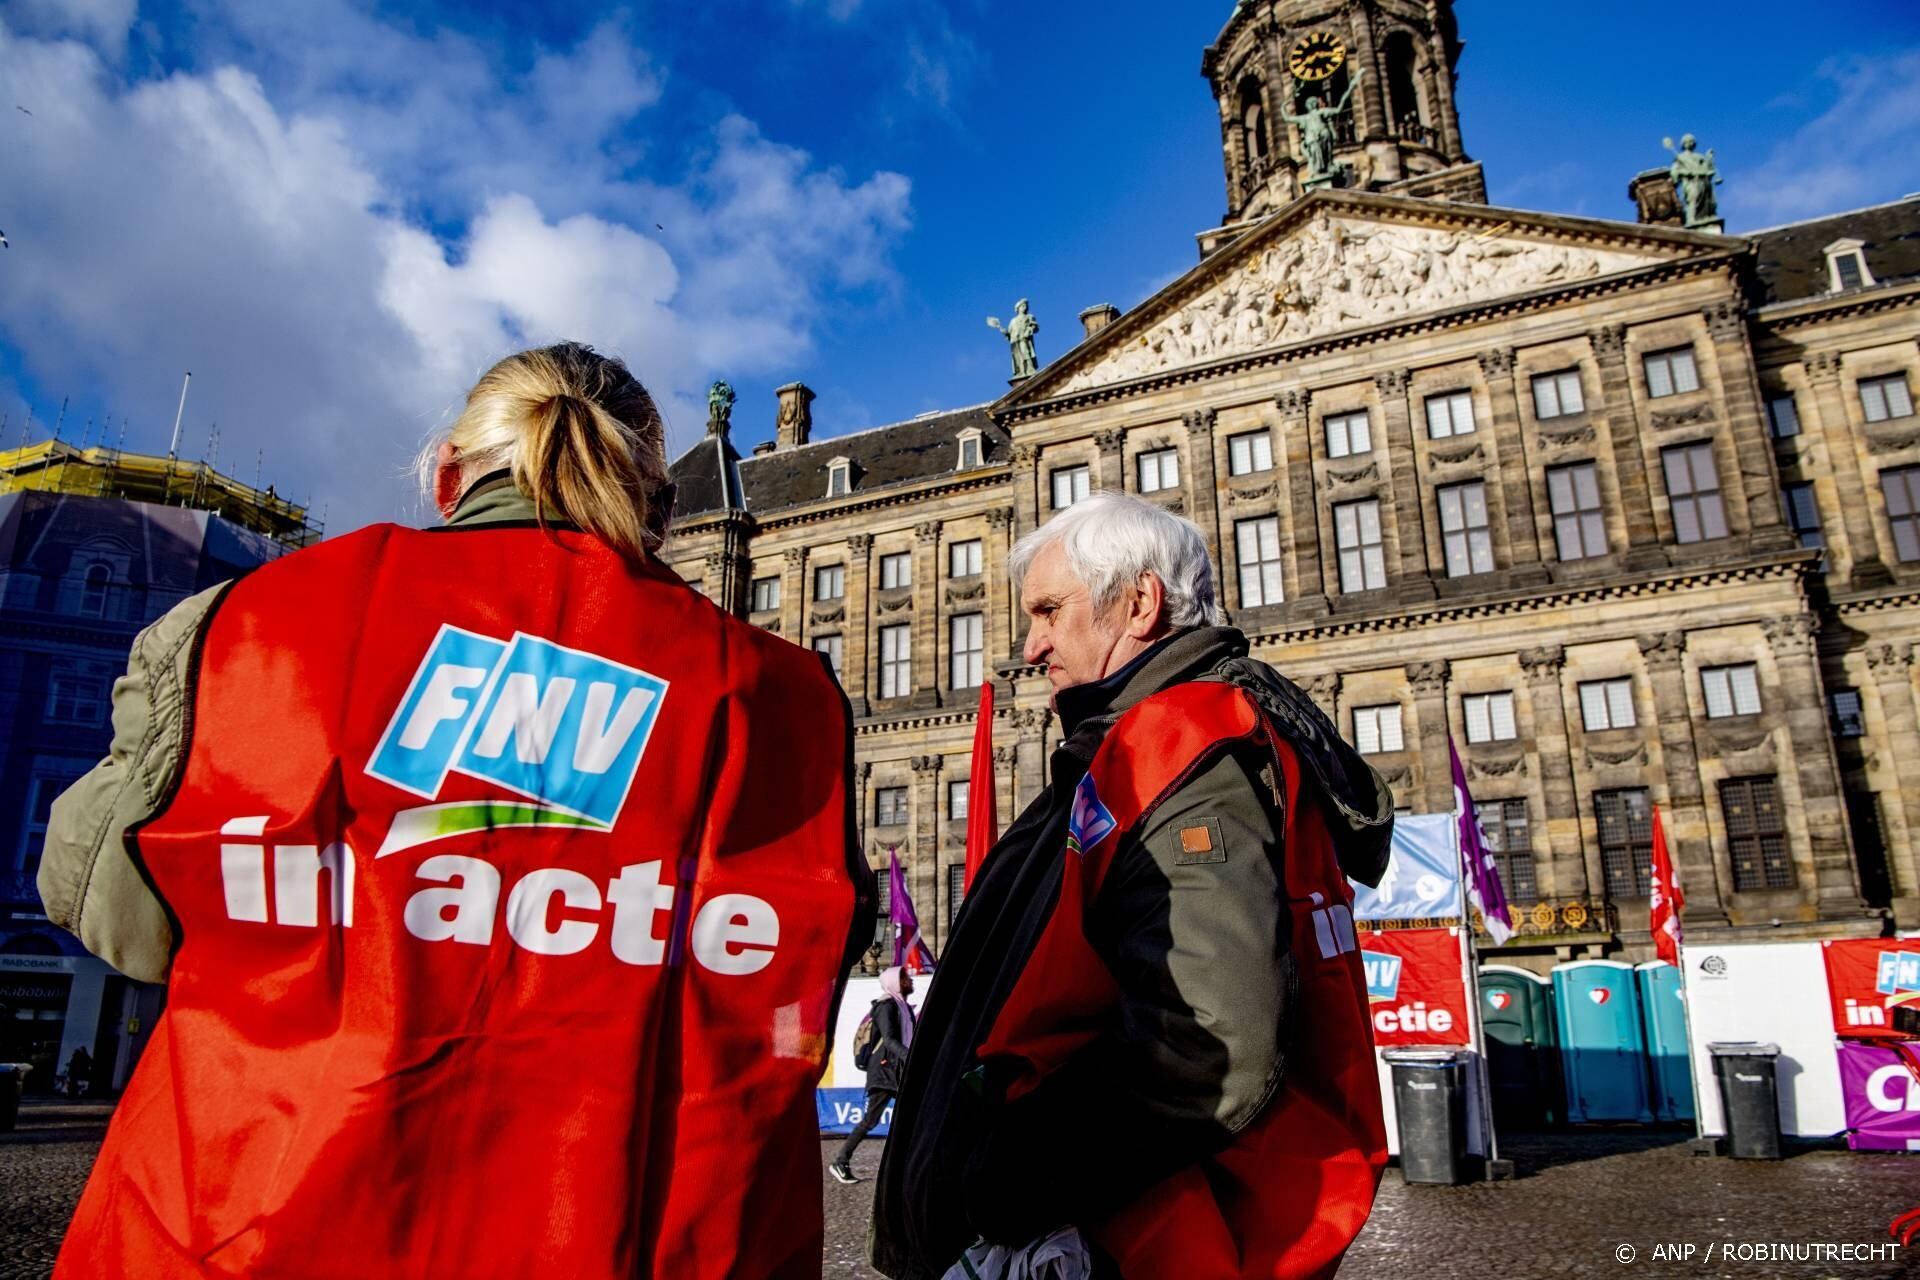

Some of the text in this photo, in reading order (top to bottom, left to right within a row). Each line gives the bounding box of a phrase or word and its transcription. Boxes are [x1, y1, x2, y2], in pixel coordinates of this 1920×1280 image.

[398, 664, 655, 774] FNV
[220, 815, 356, 928] in
[1370, 1002, 1453, 1032] ctie
[1844, 998, 1885, 1026] in
